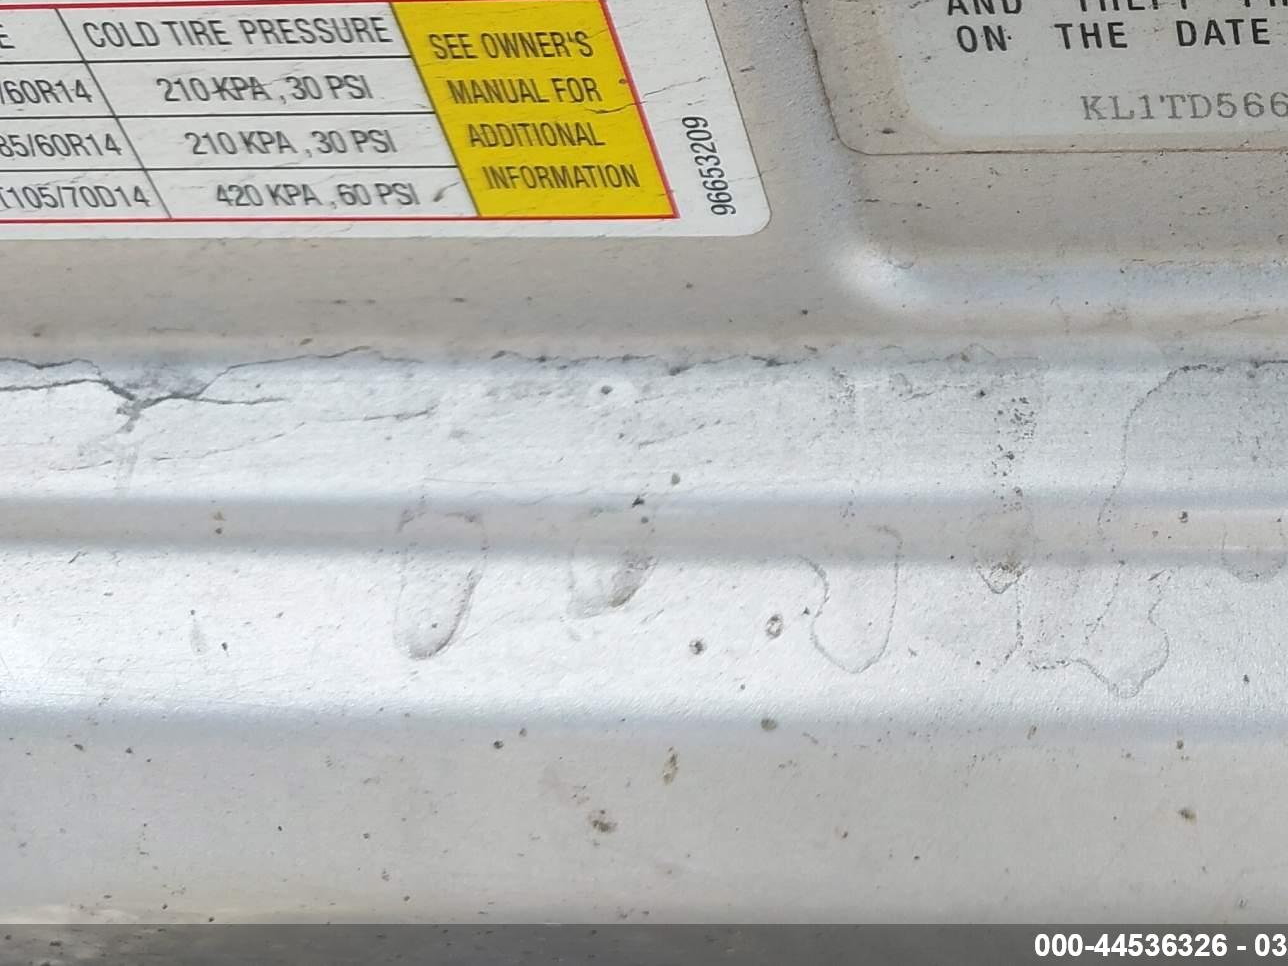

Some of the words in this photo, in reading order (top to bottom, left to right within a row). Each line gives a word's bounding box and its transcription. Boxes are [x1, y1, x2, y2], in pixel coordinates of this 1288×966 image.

[82, 21, 161, 47] COLD
[161, 20, 233, 46] TIRE
[239, 16, 394, 45] PRESSURE
[429, 33, 480, 60] SEE
[481, 30, 594, 59] OWNER'S
[956, 25, 1008, 53] ON
[1055, 21, 1128, 50] THE
[1176, 17, 1271, 46] DATE
[156, 77, 210, 102] 210
[211, 76, 271, 101] KPA
[329, 75, 374, 100] PSI
[446, 78, 549, 105] MANUAL
[553, 77, 603, 103] FOR
[184, 132, 238, 156] 210
[238, 131, 299, 155] KPA
[354, 129, 398, 154] PSI
[467, 122, 607, 148] ADDITIONAL
[482, 165, 641, 190] INFORMATION
[682, 115, 737, 216] 96653209
[216, 184, 264, 208] 420
[265, 183, 320, 207] KPA
[374, 182, 420, 206] PSI
